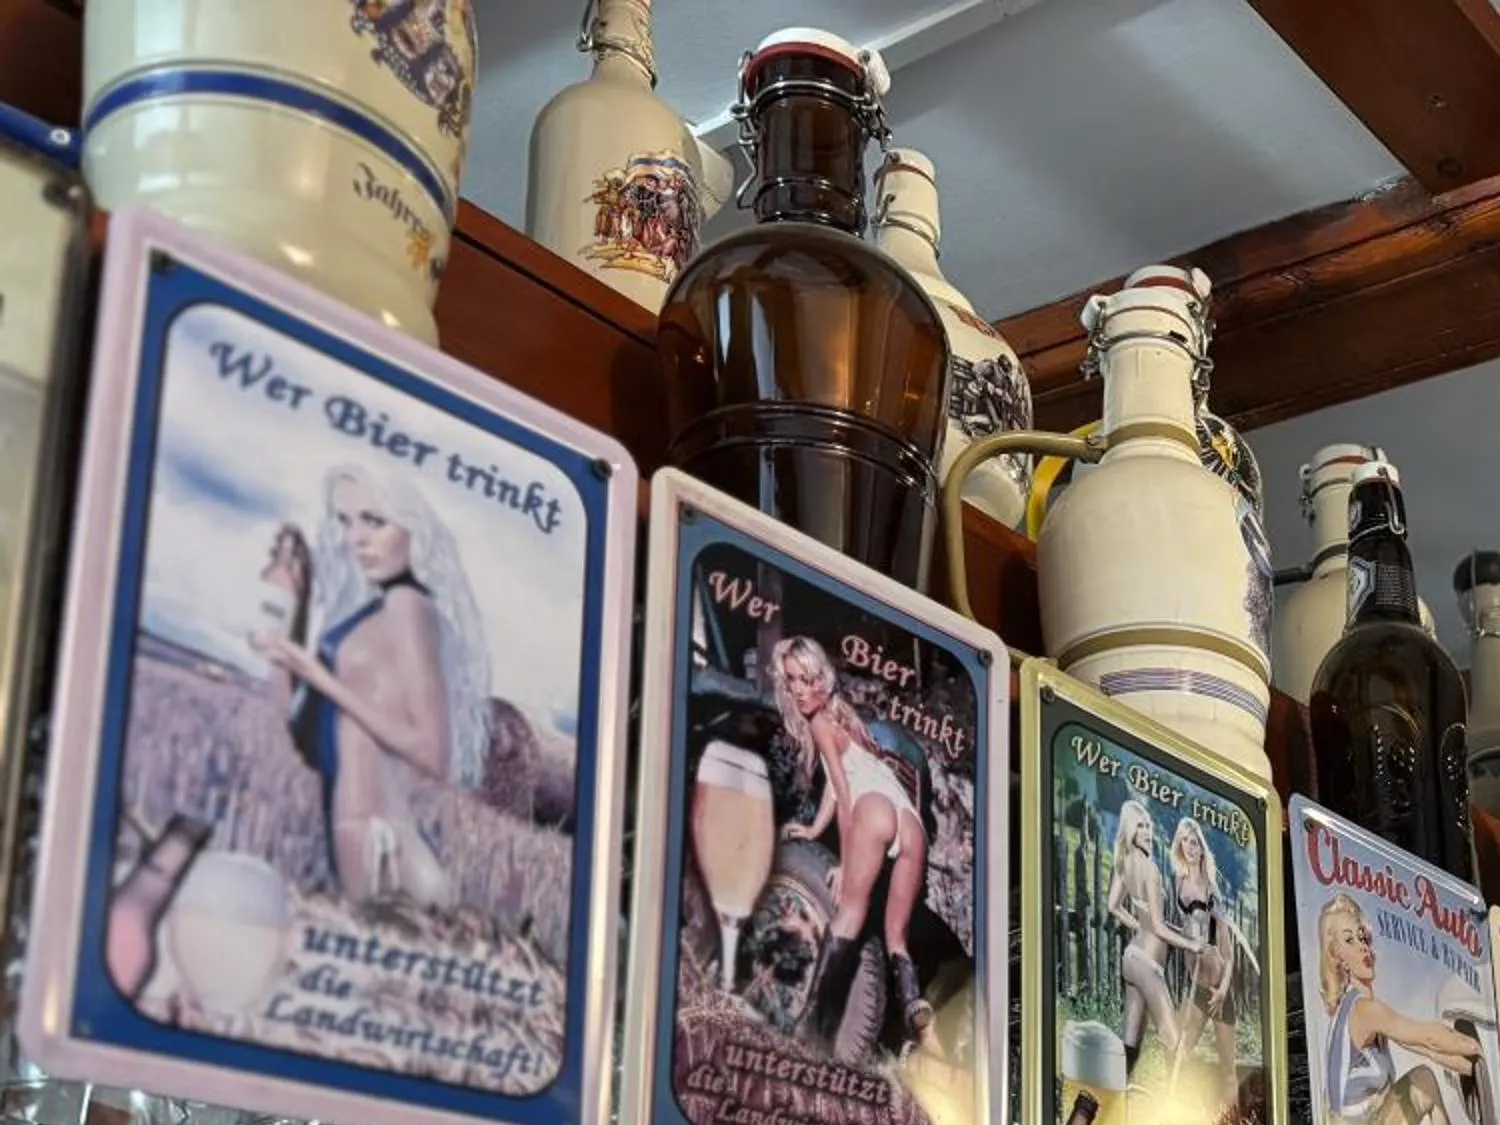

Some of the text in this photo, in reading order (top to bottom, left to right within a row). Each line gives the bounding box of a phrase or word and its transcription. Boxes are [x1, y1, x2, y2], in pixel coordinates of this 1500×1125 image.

[209, 340, 562, 534] Wer Bier trinkt
[708, 571, 781, 623] Wer
[840, 634, 917, 688] Bier
[889, 695, 966, 759] trinkt
[1071, 735, 1250, 848] Wer Bier trinkt
[1306, 822, 1484, 959] Classic Auto
[298, 962, 354, 999] die
[304, 925, 545, 1007] unterstützt
[1376, 907, 1429, 955] SERVICE
[1442, 942, 1482, 993] REPAIR
[264, 993, 545, 1079] Landwirtschaft!
[686, 1062, 724, 1093] die
[724, 1045, 890, 1104] unterstützt
